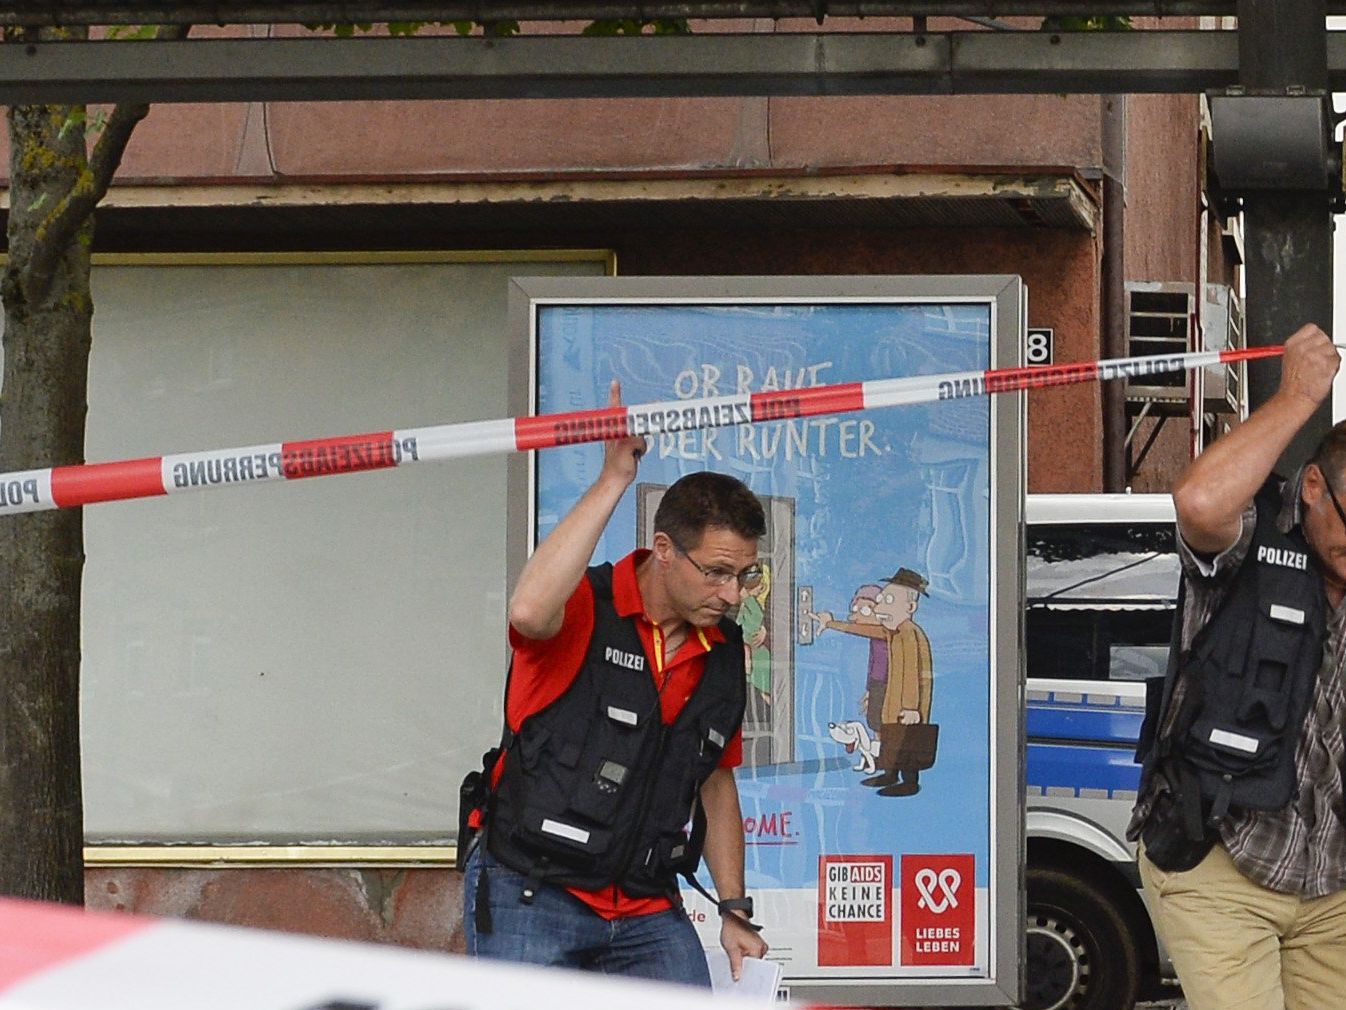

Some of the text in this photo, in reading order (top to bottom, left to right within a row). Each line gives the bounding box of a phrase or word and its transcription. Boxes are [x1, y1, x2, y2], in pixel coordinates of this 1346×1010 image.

[739, 418, 892, 461] RUNTER.
[1257, 545, 1307, 570] POLIZEI
[605, 646, 645, 671] POLIZEI
[829, 865, 882, 882] GIB AIDS
[829, 886, 882, 901] KEINE
[828, 904, 882, 919] CHANCE
[916, 928, 960, 939] LIEBES
[916, 942, 960, 953] LEBEN
